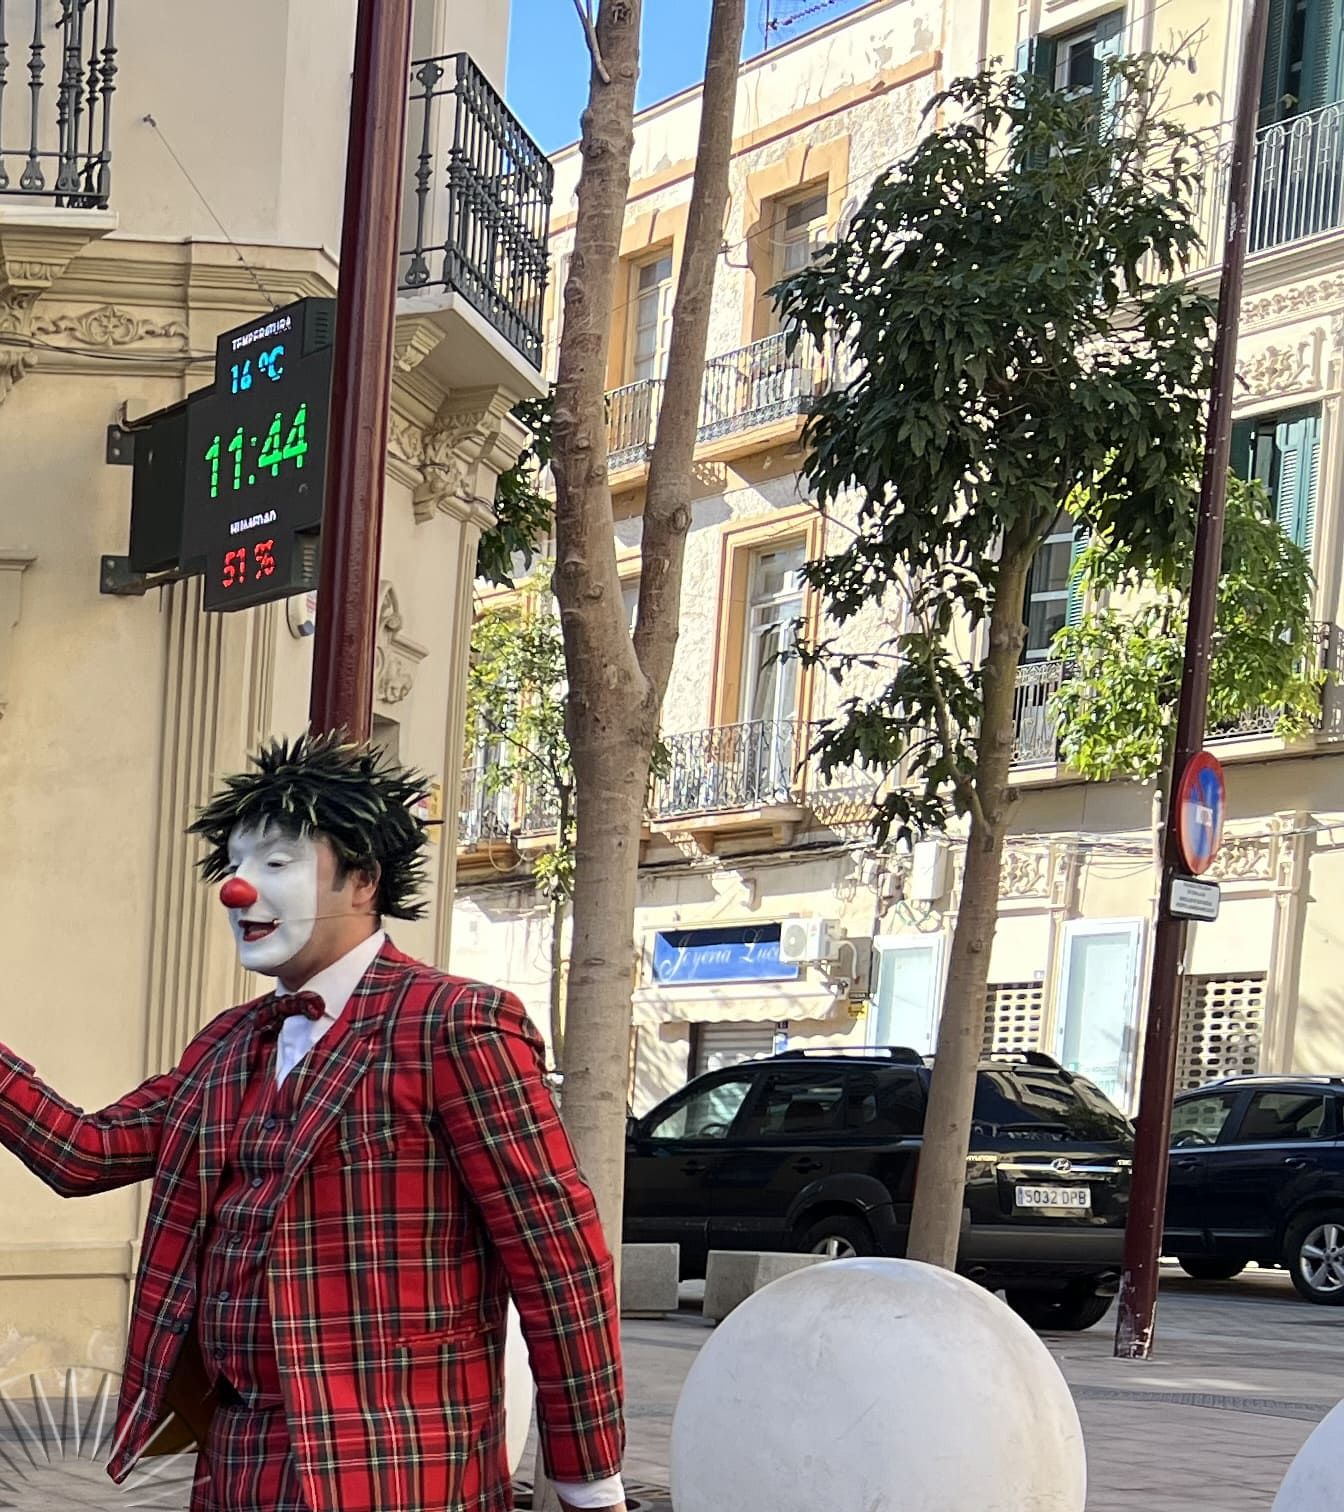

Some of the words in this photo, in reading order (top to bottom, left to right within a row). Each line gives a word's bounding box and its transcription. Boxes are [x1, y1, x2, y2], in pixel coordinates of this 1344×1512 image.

[231, 360, 252, 393] 16
[205, 403, 307, 498] 11:44
[1025, 1190, 1057, 1204] 5032
[1062, 1191, 1086, 1205] DPB
